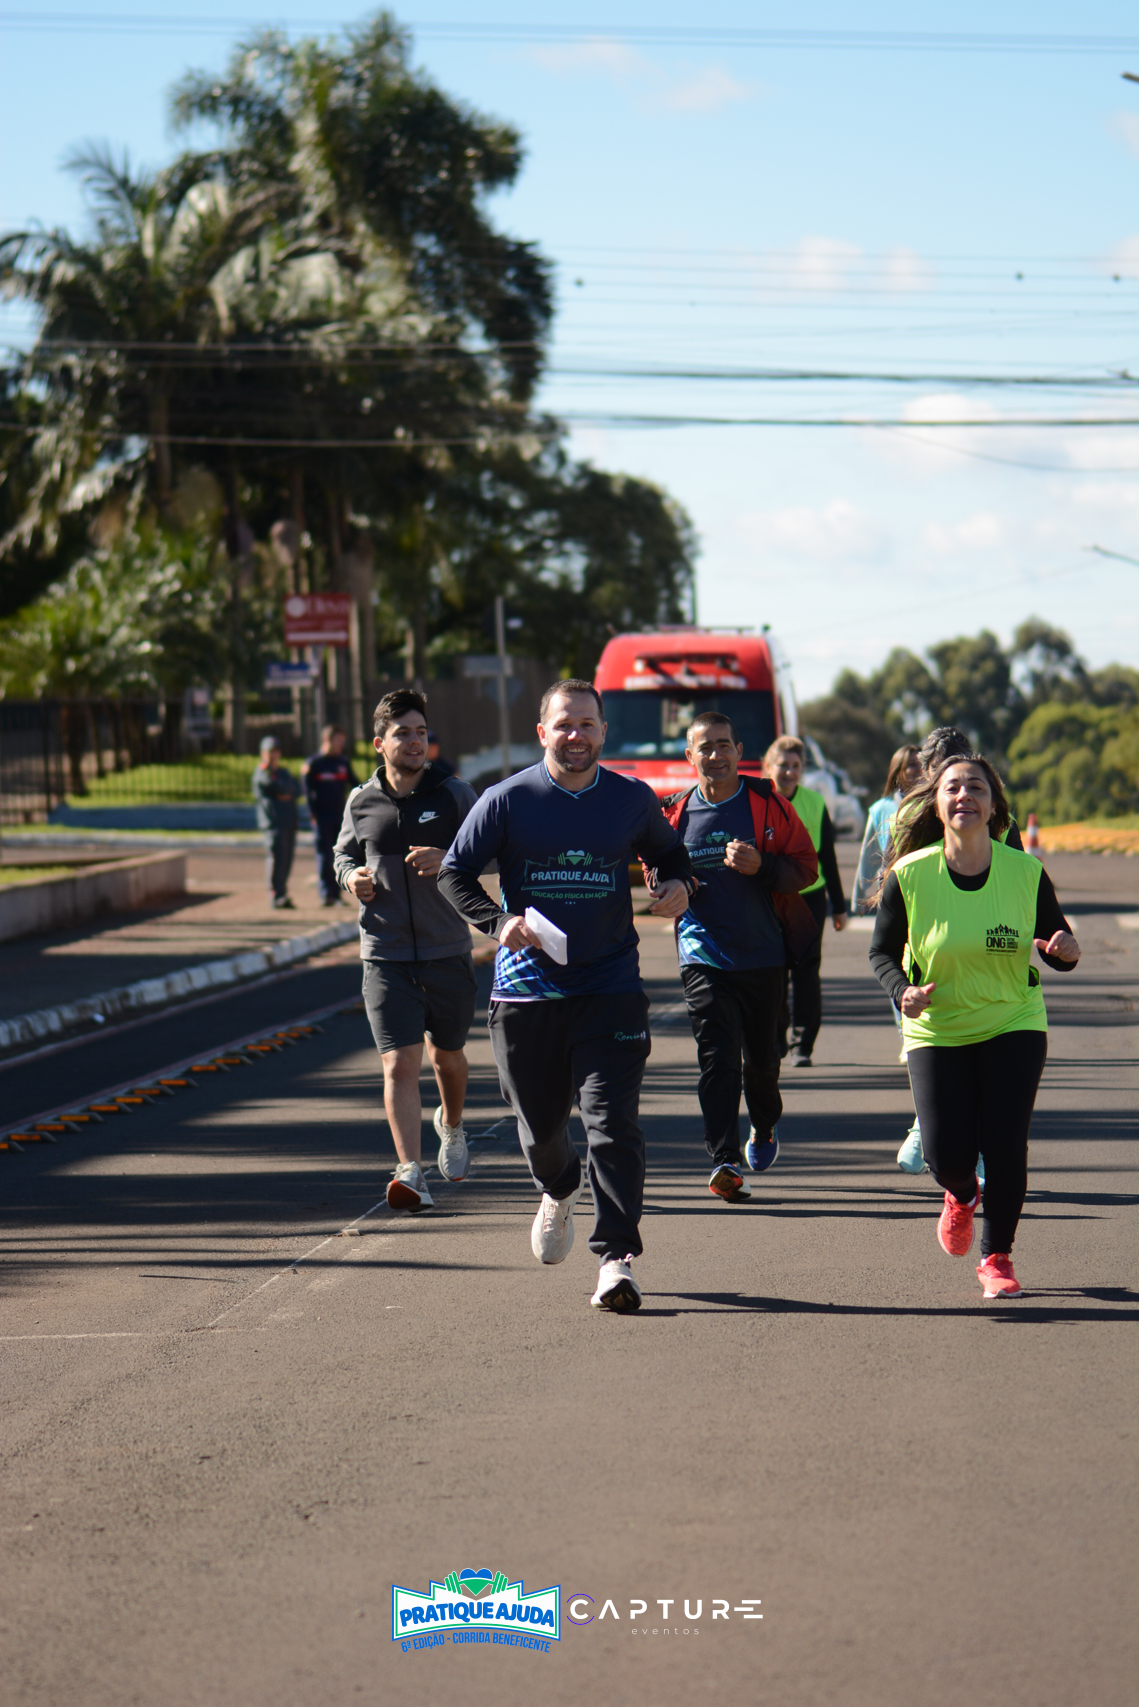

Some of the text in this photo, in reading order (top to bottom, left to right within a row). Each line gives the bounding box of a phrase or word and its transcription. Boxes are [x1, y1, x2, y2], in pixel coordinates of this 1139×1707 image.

[688, 846, 725, 859] PRATIQUE
[531, 871, 609, 883] PRATIQUE AJUDA
[531, 891, 563, 900] EDUCAÇÃO
[594, 891, 608, 900] AÇÃO
[986, 936, 1006, 948] ONG
